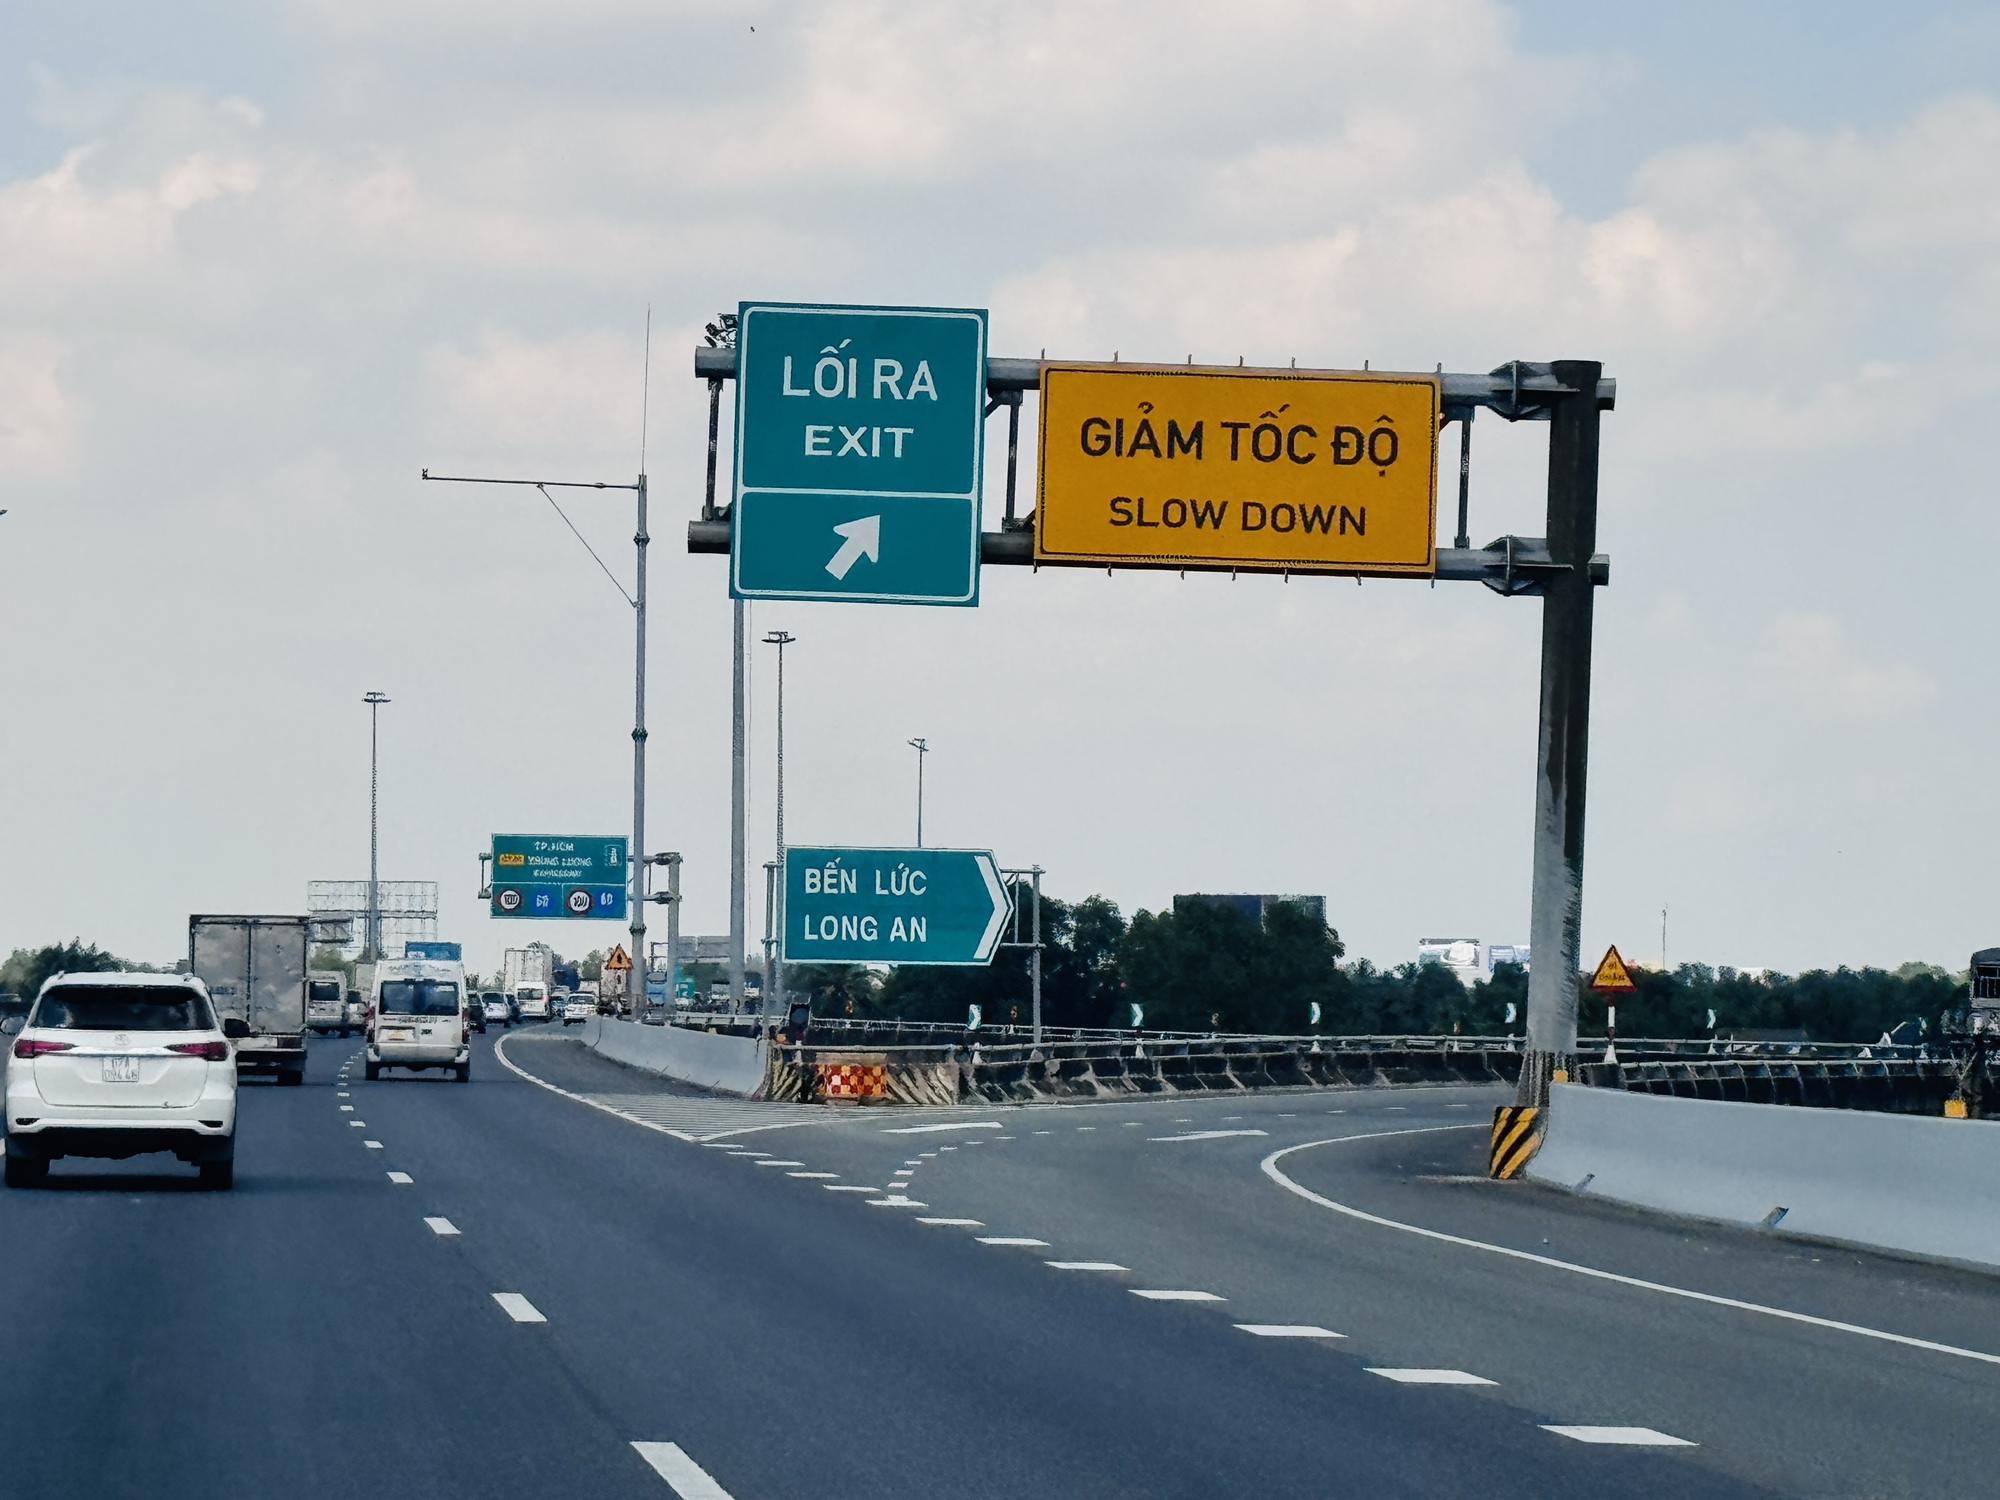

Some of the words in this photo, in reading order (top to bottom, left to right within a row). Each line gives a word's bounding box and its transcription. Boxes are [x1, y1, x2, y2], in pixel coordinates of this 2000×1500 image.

[783, 339, 857, 398] LỐI
[873, 359, 938, 401] RA
[804, 425, 914, 458] EXIT
[1080, 402, 1204, 461] GIẢM
[1220, 404, 1317, 465] TỐC
[1330, 414, 1399, 477] ĐỘ
[1109, 496, 1229, 530] SLOW
[1242, 502, 1367, 536] DOWN
[805, 857, 857, 894] BẾN
[875, 863, 927, 896] LỨC
[804, 914, 878, 941] LONG
[889, 917, 927, 942] AN
